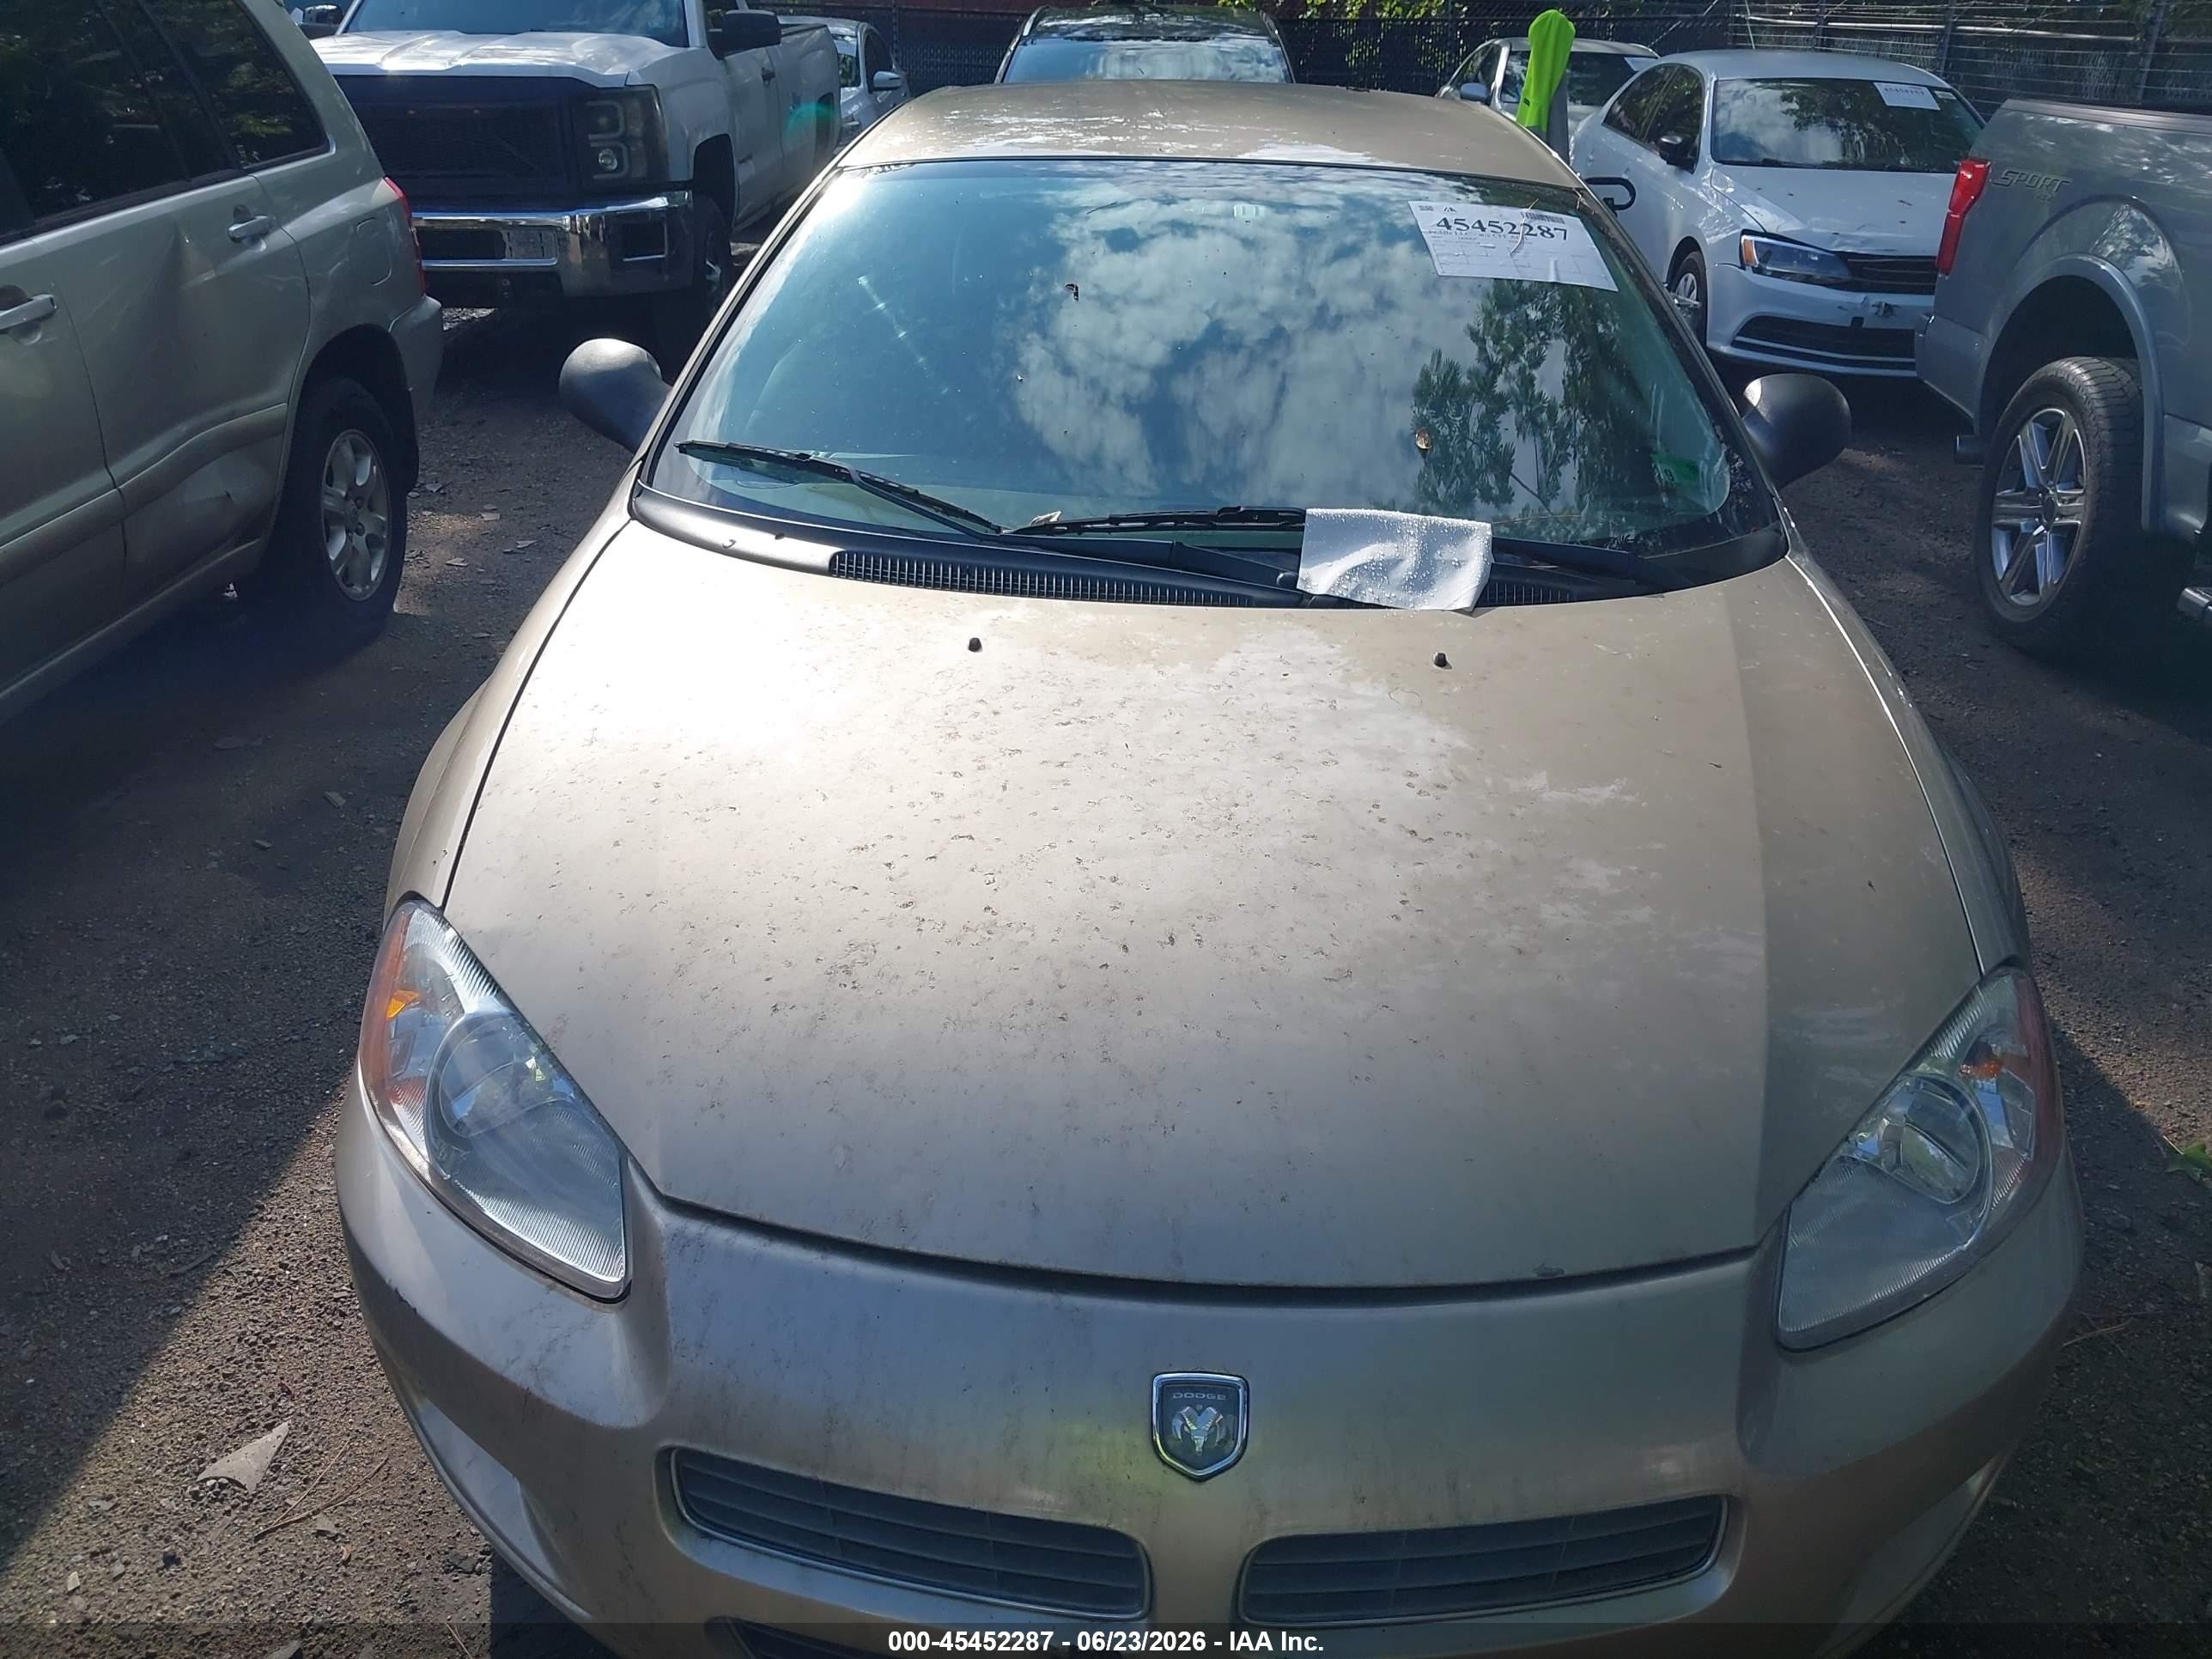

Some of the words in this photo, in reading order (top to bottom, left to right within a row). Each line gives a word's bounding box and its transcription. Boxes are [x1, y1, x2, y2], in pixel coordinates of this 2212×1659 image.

[1993, 170, 2071, 192] SPORT
[1437, 217, 1567, 241] 45452287
[1172, 1392, 1227, 1401] DODGE
